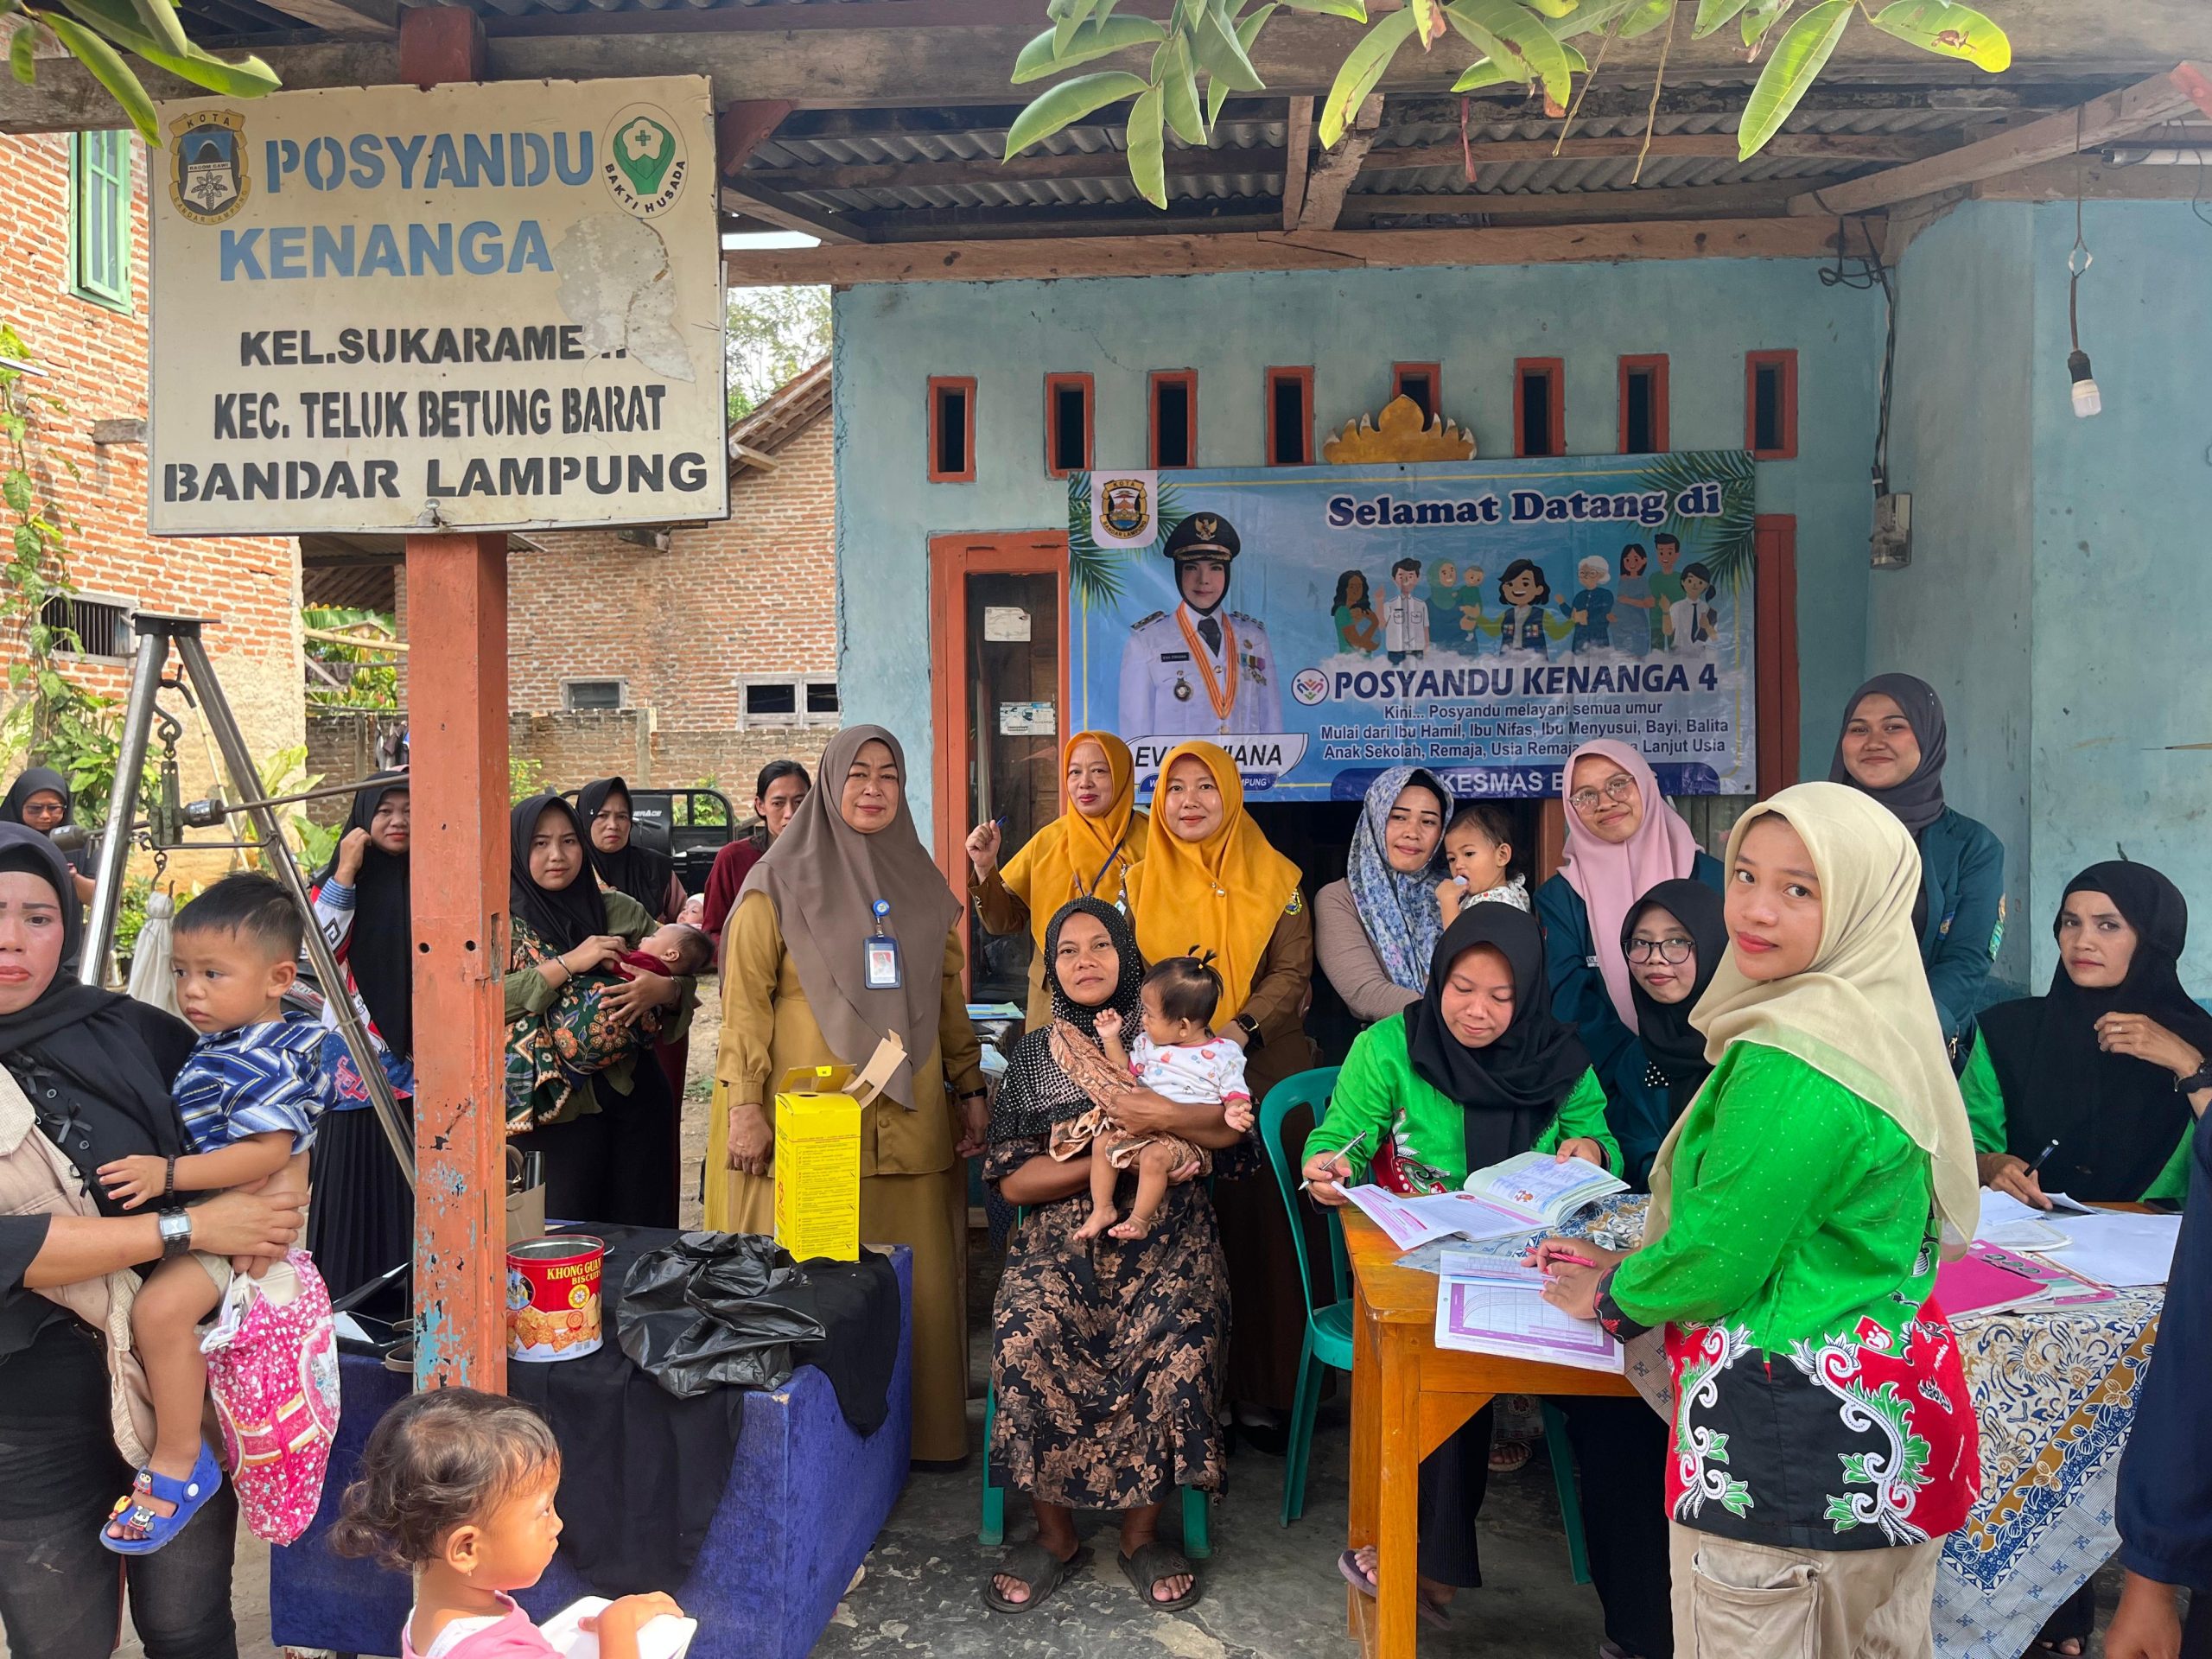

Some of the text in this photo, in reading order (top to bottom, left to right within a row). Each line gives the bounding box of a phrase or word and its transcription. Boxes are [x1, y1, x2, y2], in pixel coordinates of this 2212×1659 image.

[187, 113, 230, 129] KOTA
[266, 130, 594, 194] POSYANDU
[605, 161, 685, 213] BAKTI HUSADA
[220, 219, 554, 282] KENANGA
[214, 385, 666, 440] KEC. TELUK BETUNG BARAT
[164, 453, 708, 503] BANDAR LAMPUNG
[1328, 483, 1720, 527] Selamat Datang di
[1334, 664, 1718, 699] POSYANDU KENANGA 4
[1384, 702, 1662, 721] Kini... Posyandu melayani semua umur
[1320, 718, 1728, 740] Mulai dari Ibu Hamil, Ibu Nifas, Ibu Menyusui, Bayi, Balita
[1135, 747, 1175, 766] EV
[1323, 745, 1361, 759] Anak
[1364, 744, 1426, 760] Sekolah,
[1430, 743, 1486, 759] Remaja,
[1491, 742, 1522, 755] Usia
[1643, 739, 1688, 755] Lanjut
[1693, 739, 1726, 752] Usia
[1440, 772, 1543, 792] KESMAS
[547, 1264, 583, 1280] KHONG
[572, 1269, 601, 1285] BISCUITS
